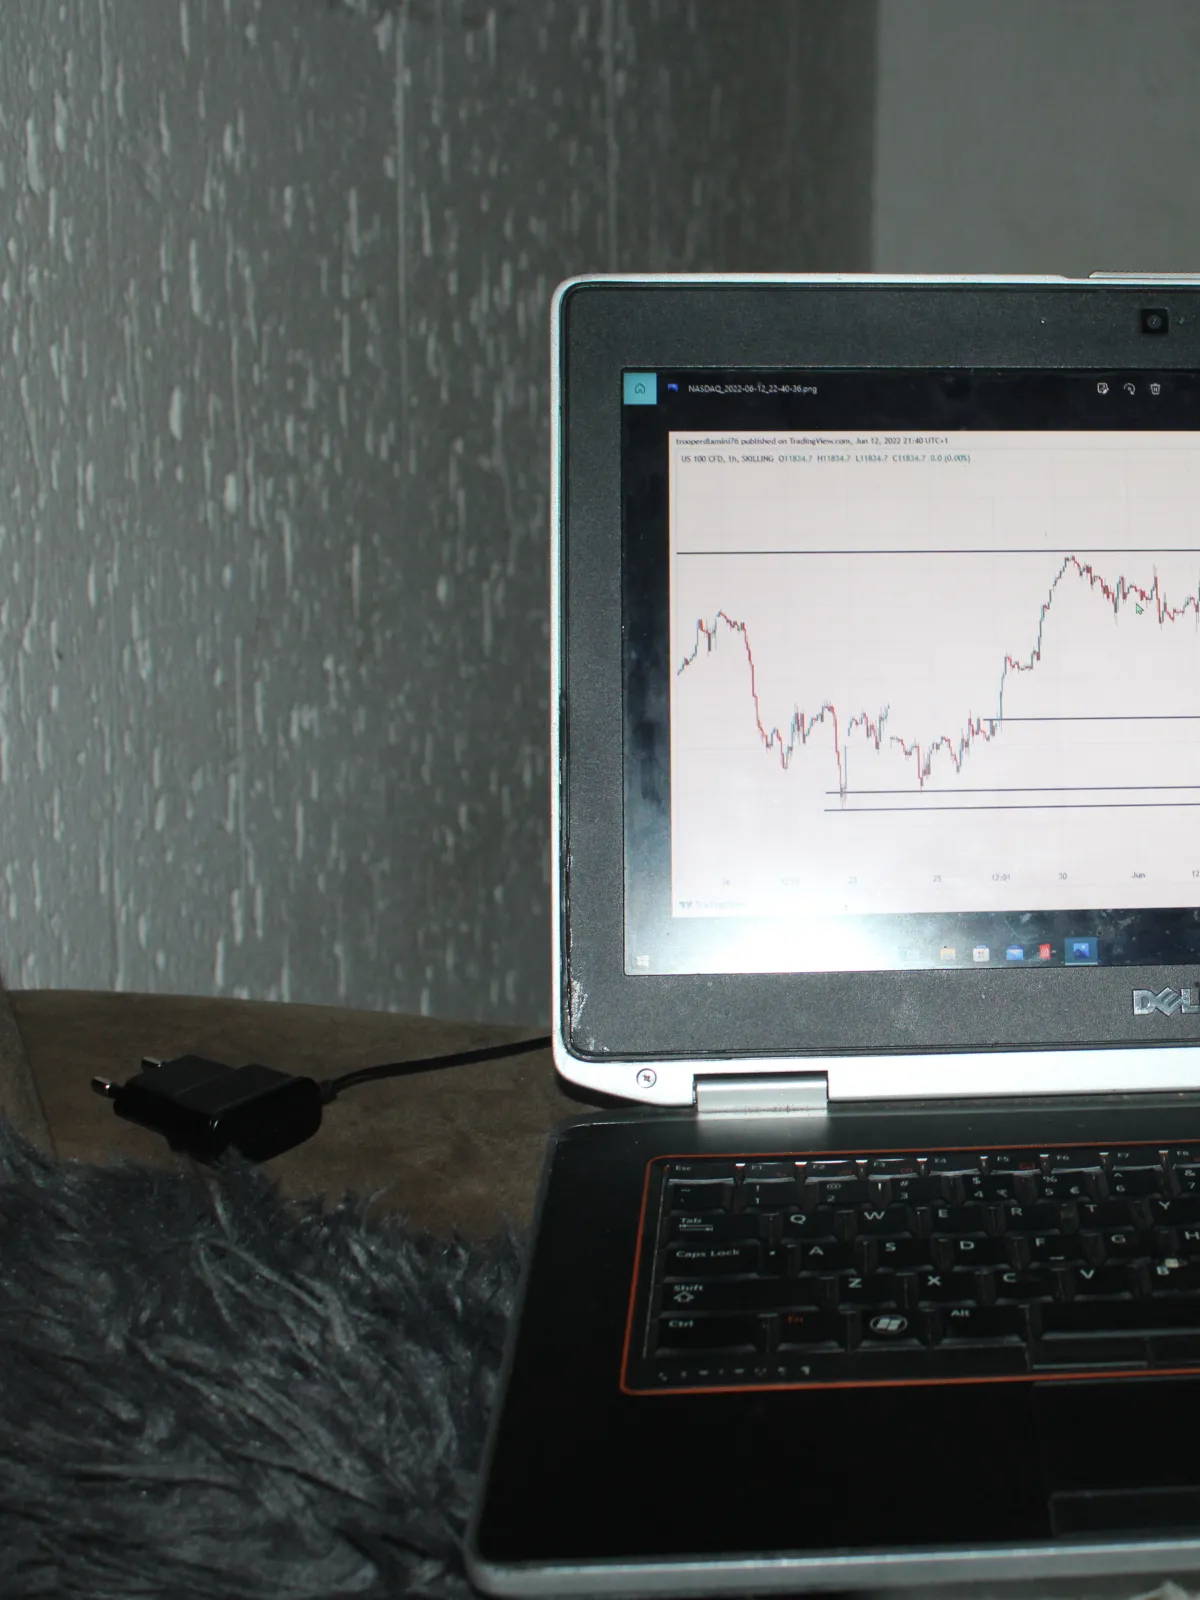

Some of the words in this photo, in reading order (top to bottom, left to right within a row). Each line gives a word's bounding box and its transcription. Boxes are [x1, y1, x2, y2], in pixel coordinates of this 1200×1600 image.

[688, 384, 817, 394] NASDAQ_2022-06-12_22-40-36.png
[741, 438, 776, 446] published
[930, 454, 942, 462] 0.0
[991, 873, 1011, 881] 12:01
[1058, 872, 1067, 880] 30
[1131, 871, 1145, 879] Jun
[972, 1177, 981, 1185] $
[1116, 1184, 1125, 1192] 6
[900, 1192, 908, 1200] 3
[1085, 1204, 1097, 1213] T
[1158, 1201, 1171, 1210] Y
[864, 1211, 885, 1220] W
[938, 1209, 948, 1218] E
[1011, 1207, 1023, 1216] R
[790, 1214, 806, 1224] Q
[1111, 1235, 1126, 1244] G
[1185, 1231, 1200, 1240] H
[960, 1241, 975, 1250] D
[1035, 1238, 1046, 1246] F
[809, 1246, 824, 1256] A
[885, 1242, 896, 1252] S
[676, 1250, 707, 1258] Caps
[710, 1248, 740, 1257] Lock
[1080, 1269, 1095, 1279] V
[1156, 1266, 1170, 1276] B
[927, 1276, 941, 1286] X
[1003, 1272, 1017, 1283] C
[848, 1278, 862, 1288] Z
[674, 1284, 704, 1292] Shift
[951, 1309, 970, 1317] Alt
[669, 1319, 694, 1328] Ctrl
